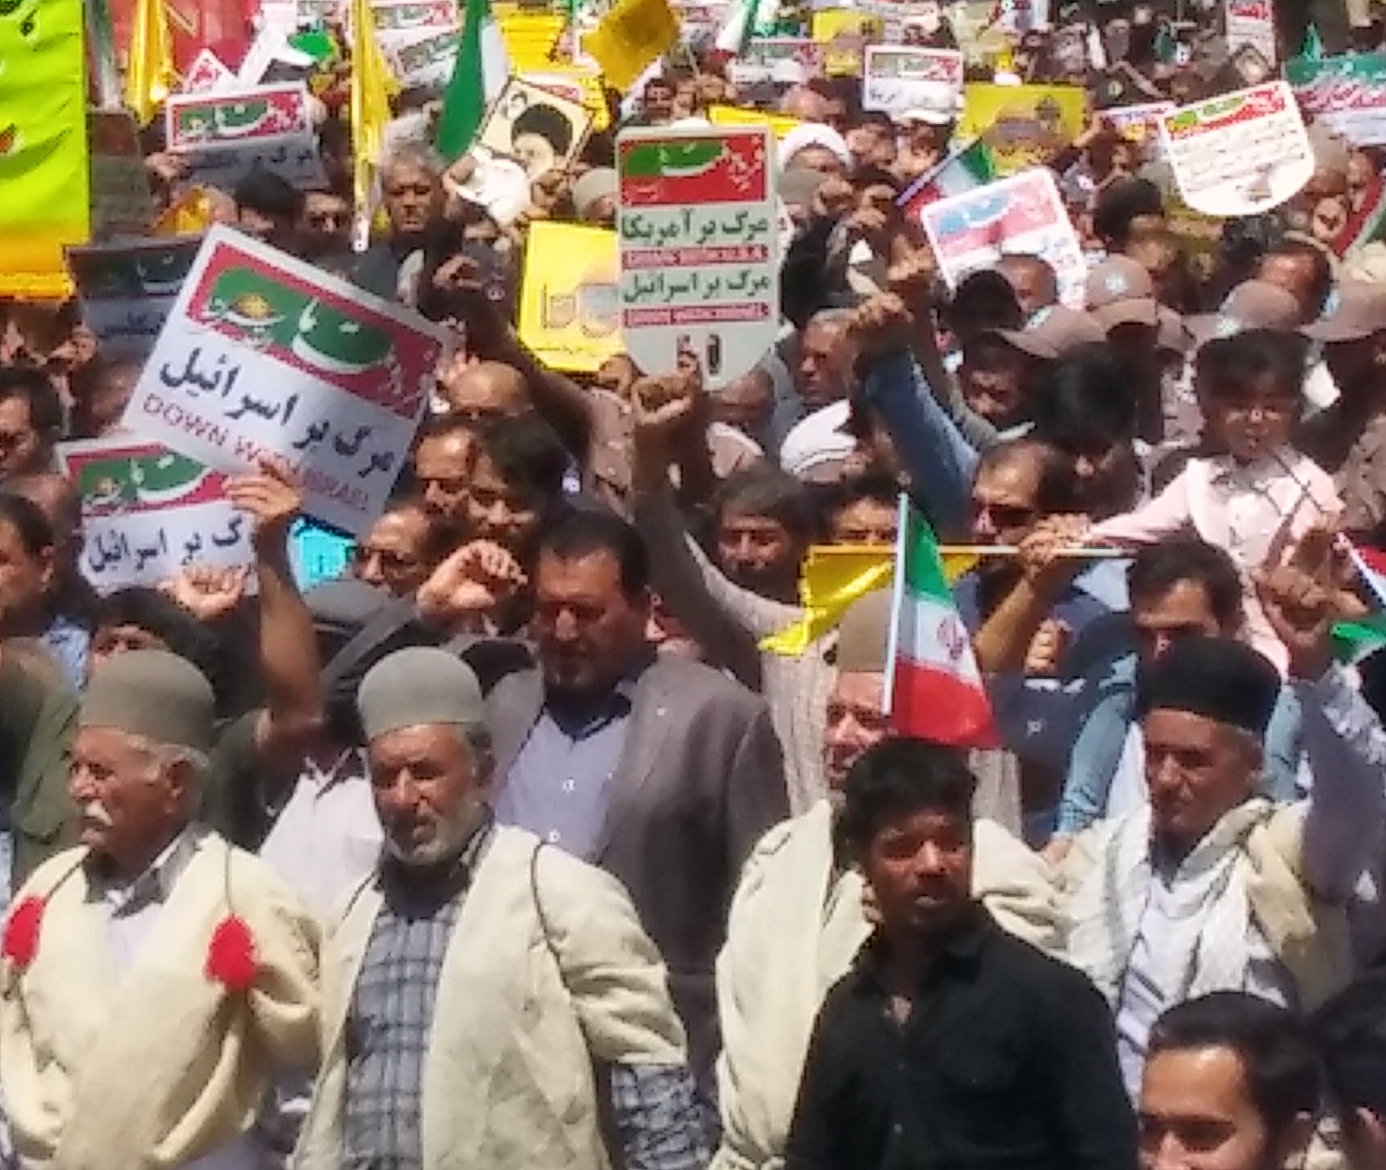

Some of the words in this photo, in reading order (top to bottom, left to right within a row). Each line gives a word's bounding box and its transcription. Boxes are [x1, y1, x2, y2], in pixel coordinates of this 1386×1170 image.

[721, 211, 769, 241] مرگ
[727, 270, 770, 297] مرگ
[159, 346, 299, 426] اسرائیل
[142, 392, 231, 449] DOWN
